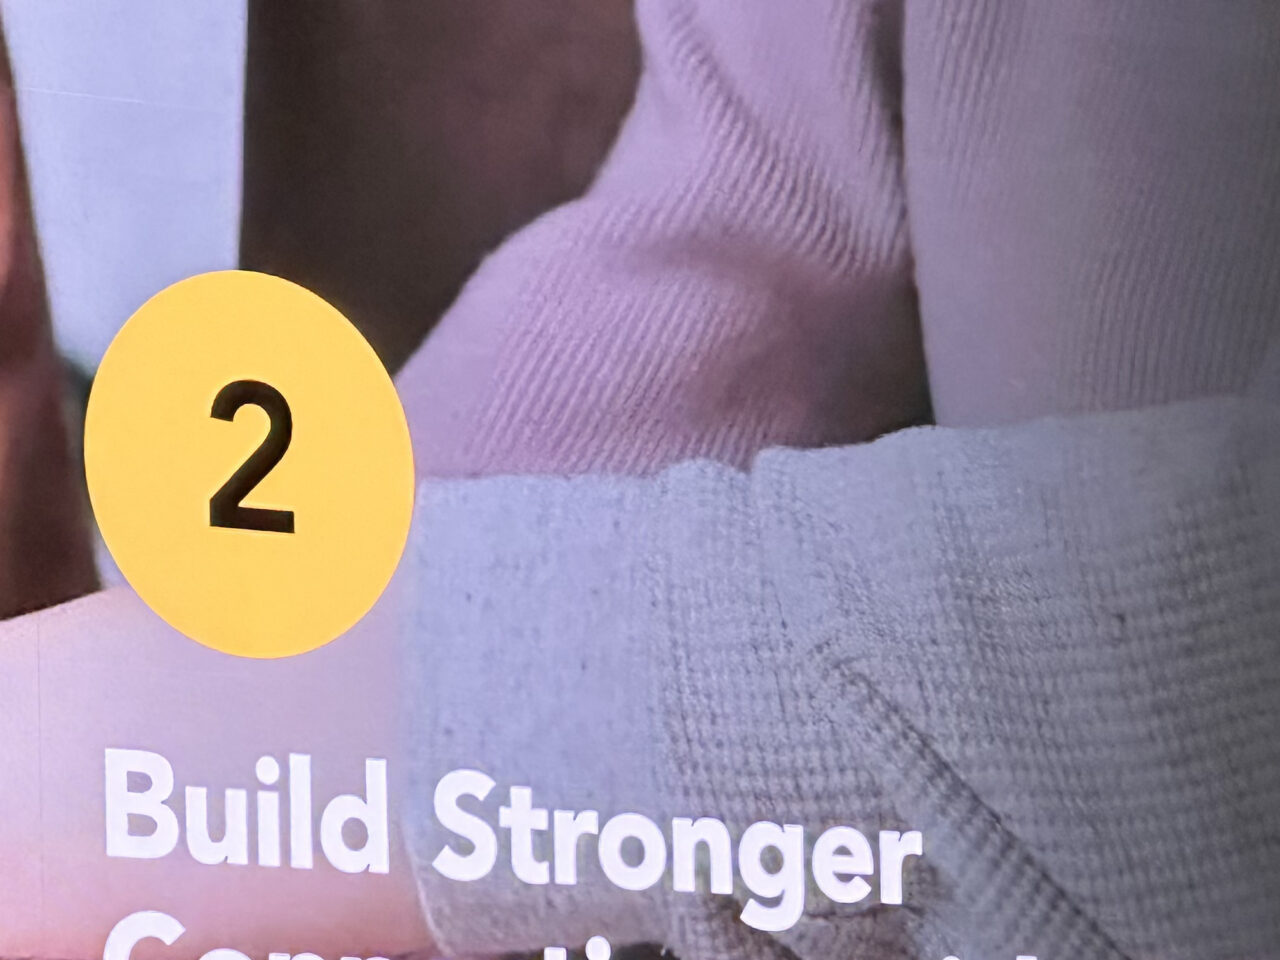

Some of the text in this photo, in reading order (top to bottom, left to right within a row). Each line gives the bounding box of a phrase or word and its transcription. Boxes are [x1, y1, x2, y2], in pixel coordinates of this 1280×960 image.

[210, 379, 295, 533] 2
[105, 748, 923, 932] Build Stronger
